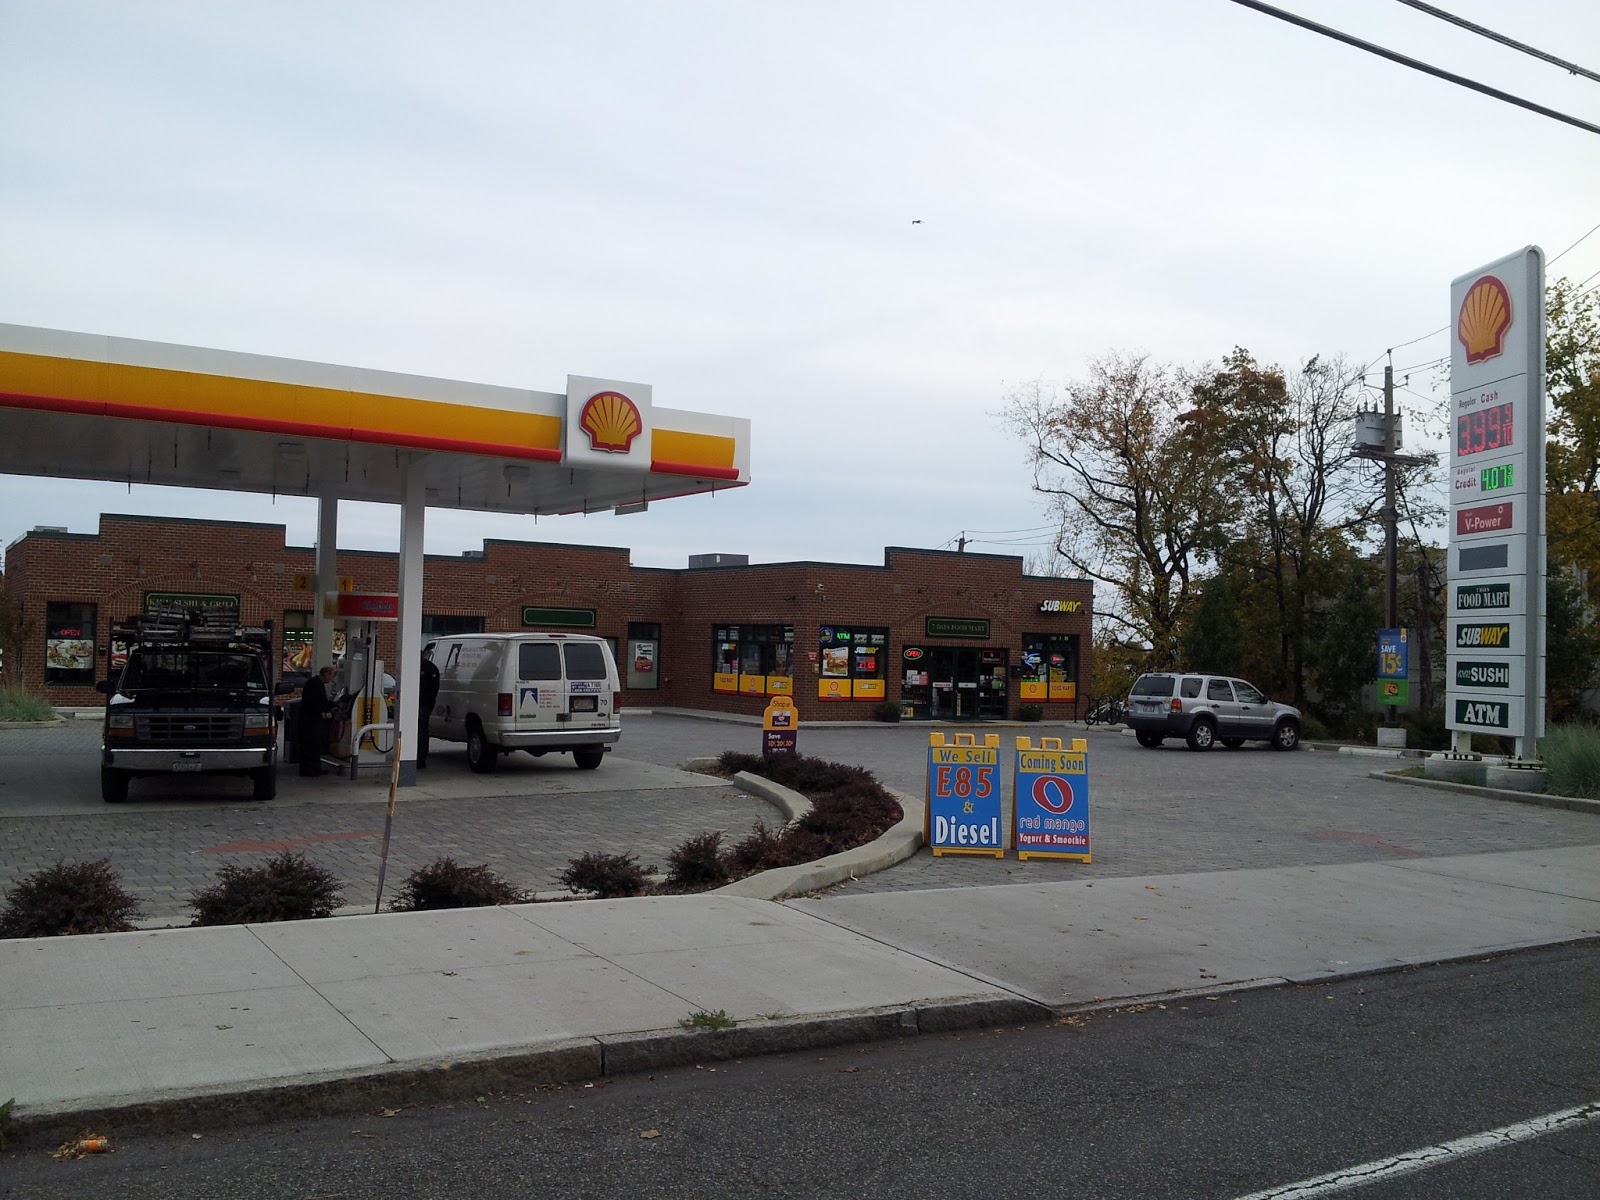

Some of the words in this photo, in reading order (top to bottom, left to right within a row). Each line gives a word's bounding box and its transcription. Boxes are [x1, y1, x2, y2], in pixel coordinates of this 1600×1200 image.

[1459, 397, 1477, 409] Regular
[1481, 390, 1499, 404] Cash
[1457, 466, 1476, 476] Regular
[1455, 477, 1477, 490] Credit
[1465, 517, 1502, 531] V-Power
[299, 576, 307, 589] 2
[1458, 593, 1482, 608] FOOD
[1483, 591, 1509, 607] MART
[1040, 600, 1081, 613] SUBWAY
[61, 627, 80, 636] OPEN
[837, 632, 851, 640] ATM
[1458, 626, 1509, 645] SUBWAY
[854, 646, 879, 654] SUBWAY
[1381, 644, 1397, 653] SAVE
[1471, 667, 1509, 683] SUSHI
[773, 700, 785, 709] Shop
[1463, 703, 1500, 724] ATM
[768, 732, 781, 740] Save
[940, 750, 959, 762] We
[965, 750, 991, 763] Sell
[1020, 753, 1057, 772] Coming
[1060, 755, 1084, 771] Soon
[936, 766, 994, 798] E85
[963, 799, 974, 814] &
[935, 815, 998, 845] Diesel
[1019, 815, 1041, 829] red
[1044, 817, 1085, 833] mango
[1019, 833, 1042, 844] Yogurt
[1044, 833, 1051, 843] &
[1052, 834, 1086, 845] Smoothie
